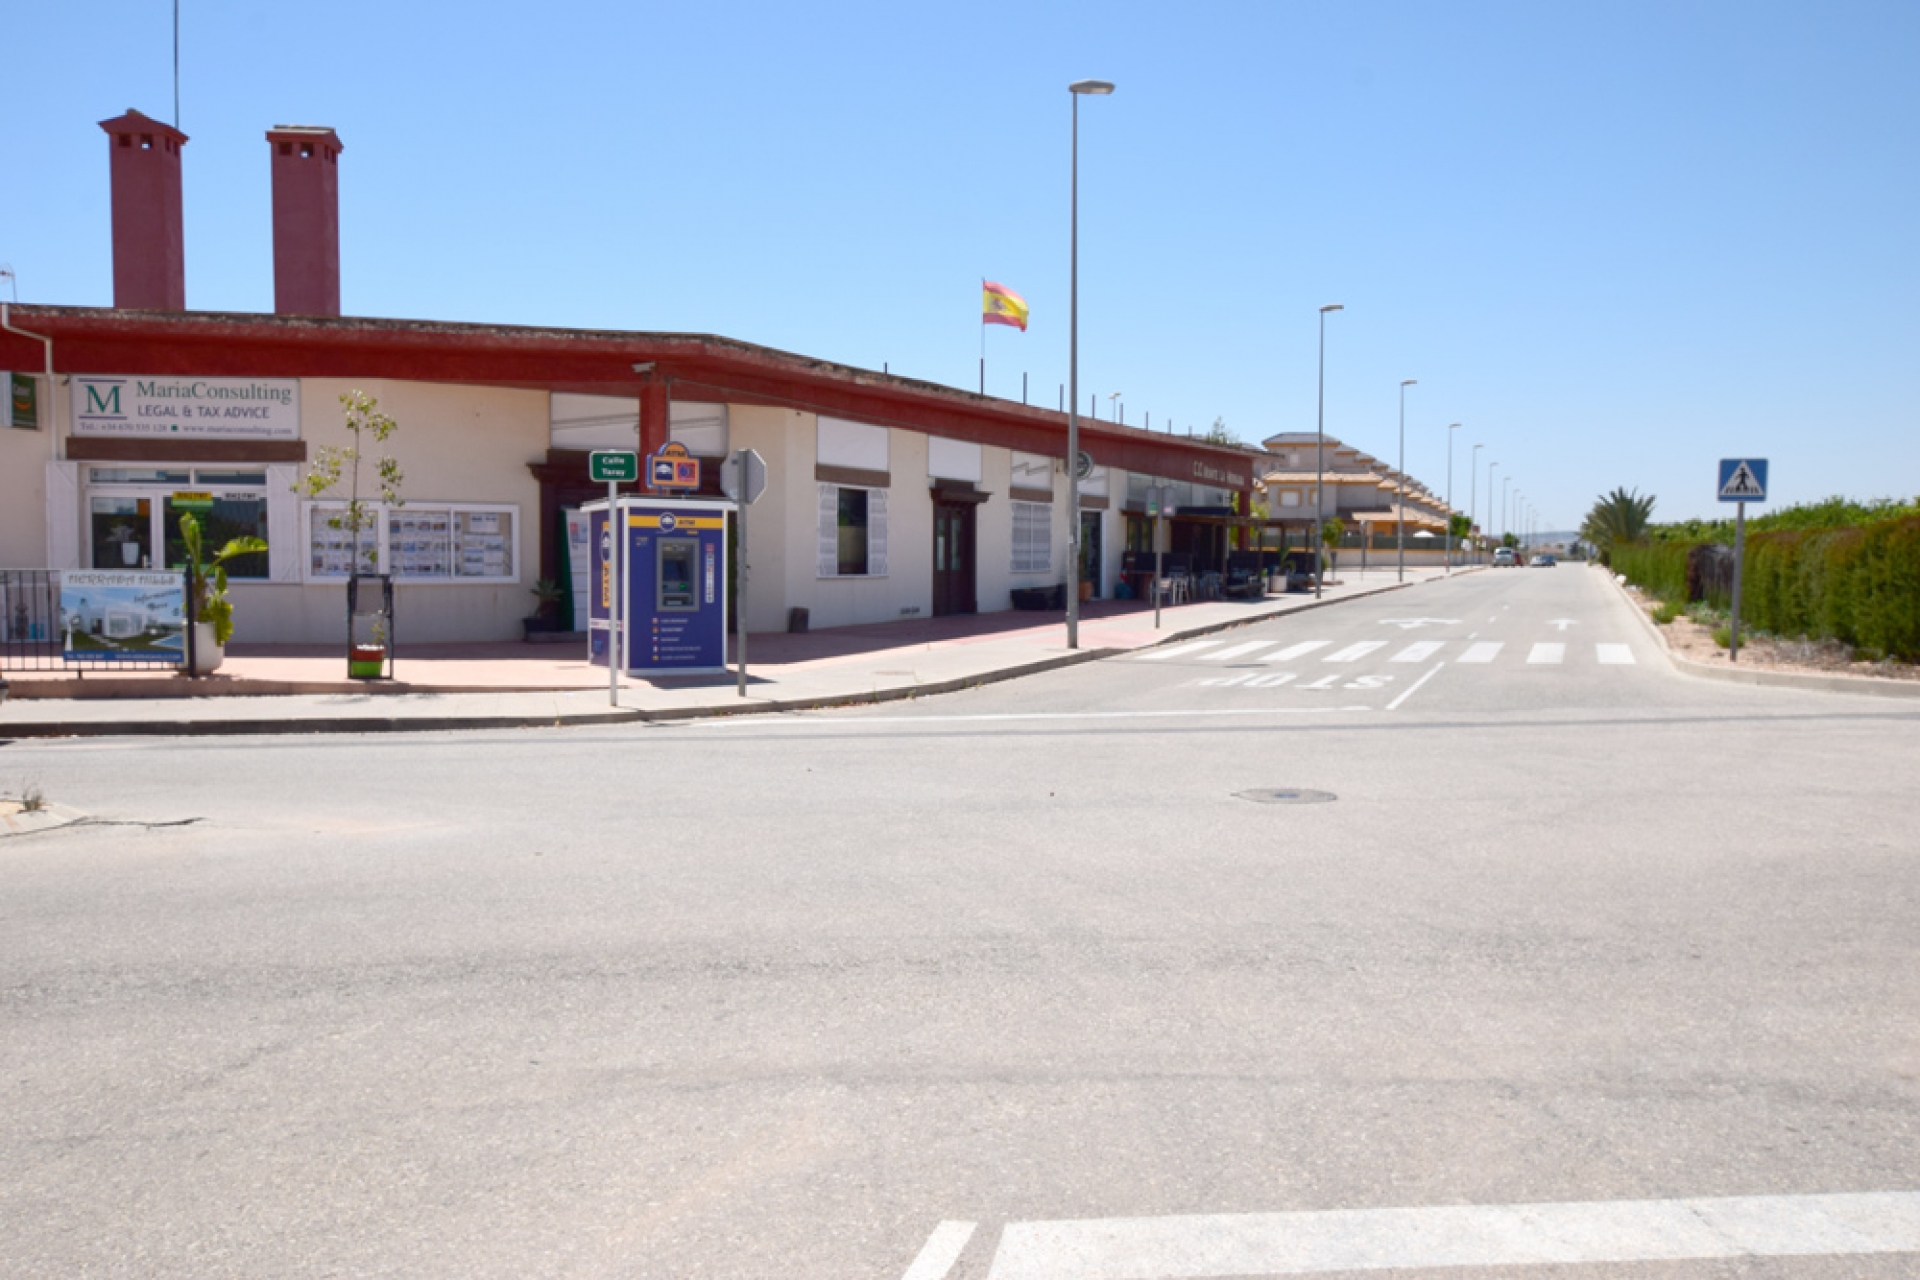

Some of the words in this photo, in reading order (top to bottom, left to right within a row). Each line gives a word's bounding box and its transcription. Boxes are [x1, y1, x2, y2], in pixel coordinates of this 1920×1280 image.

[86, 385, 122, 414] M
[136, 381, 292, 404] MariaConsulting
[138, 405, 178, 417] LEGAL
[182, 406, 192, 417] &
[197, 407, 219, 418] TAX
[223, 407, 270, 419] ADVICE
[602, 456, 625, 465] Calle
